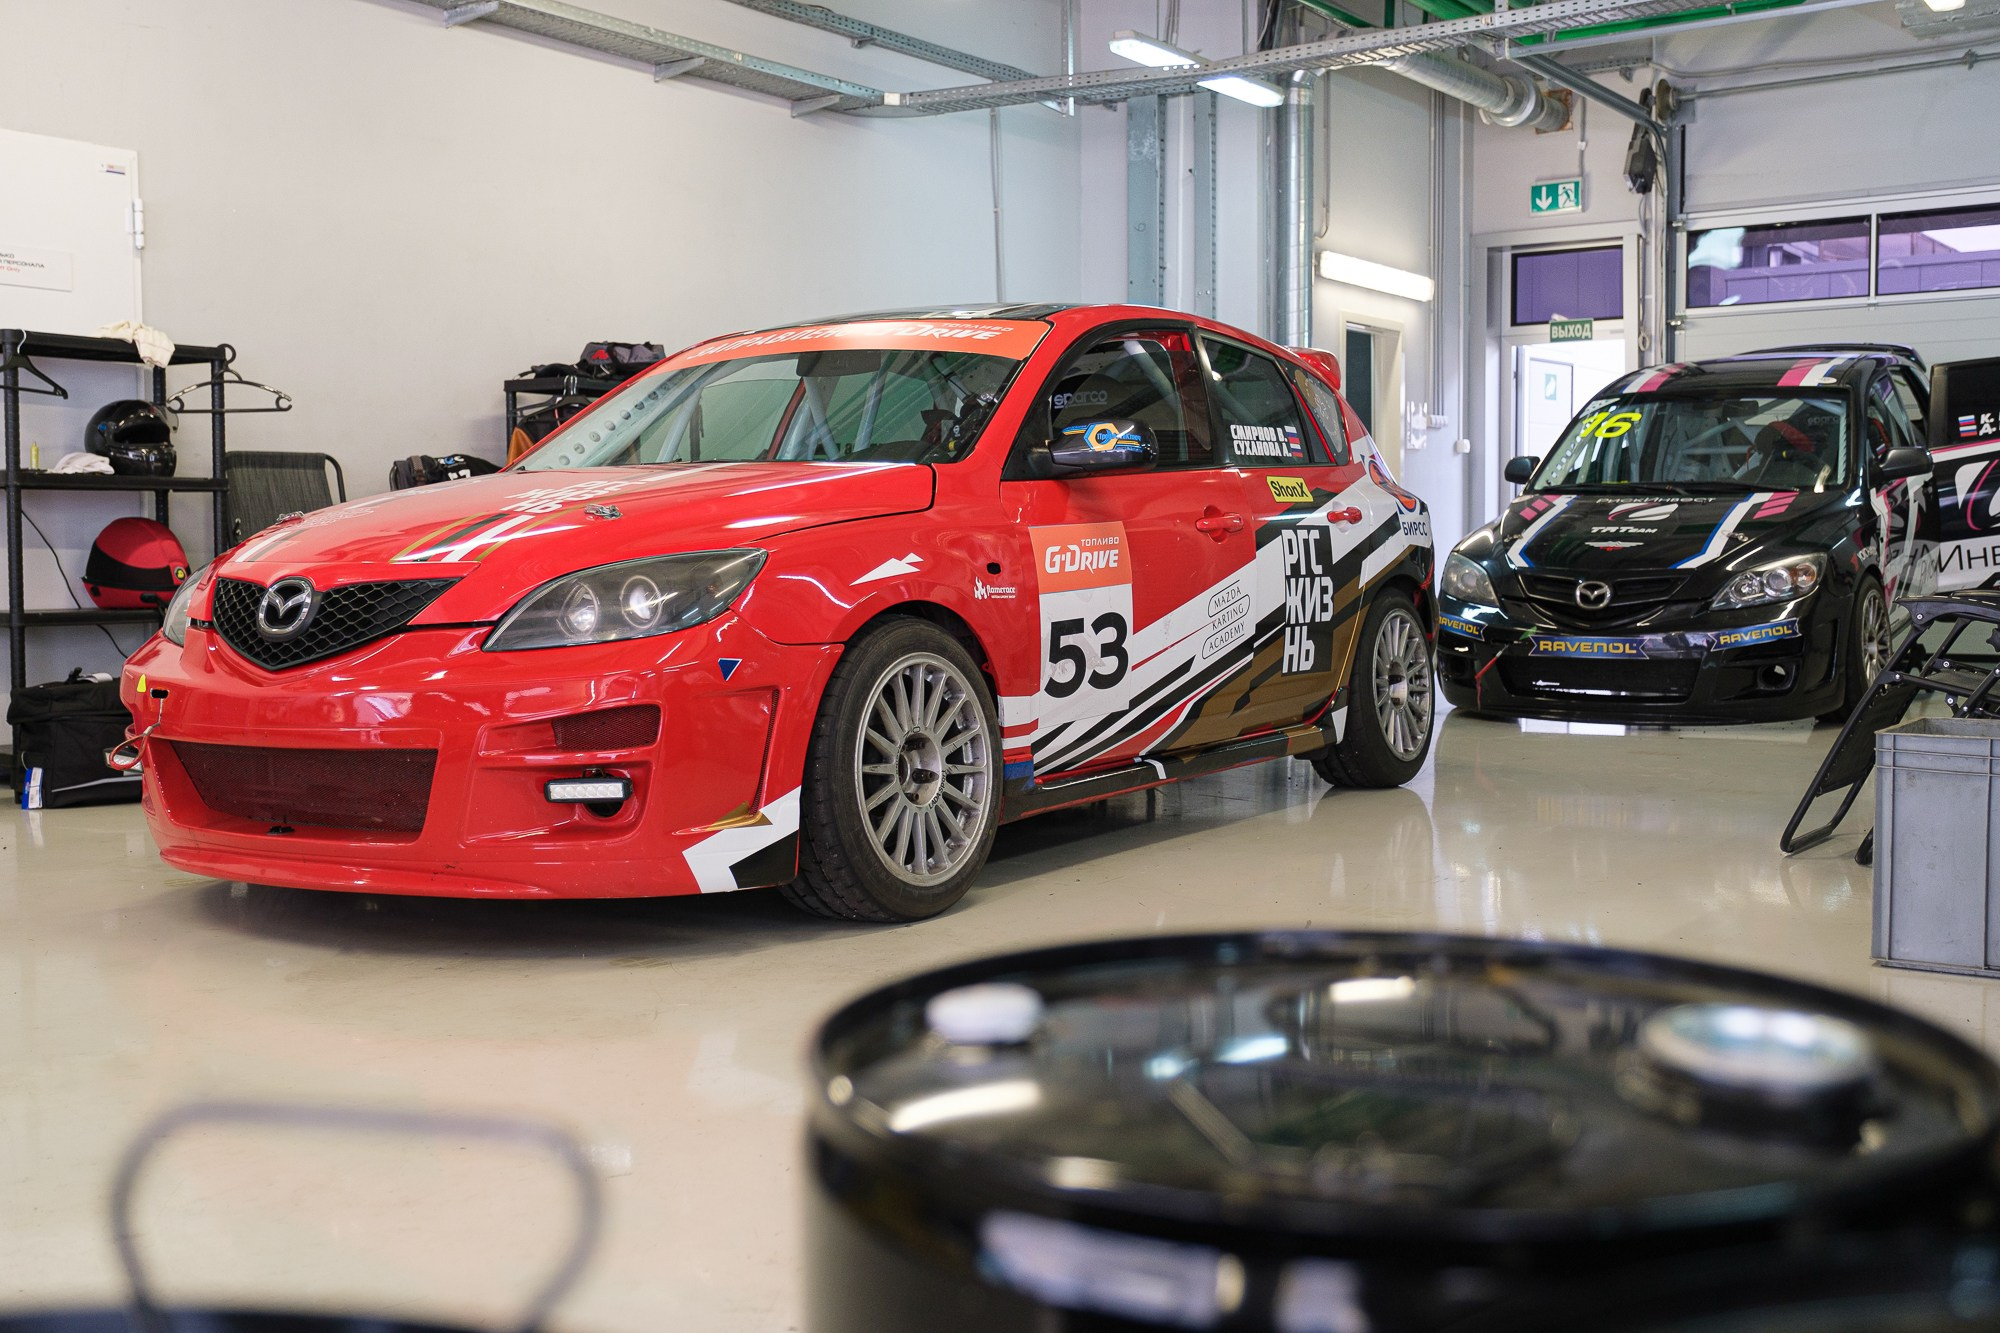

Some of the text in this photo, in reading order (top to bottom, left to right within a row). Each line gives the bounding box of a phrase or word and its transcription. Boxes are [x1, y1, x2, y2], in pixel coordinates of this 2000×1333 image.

[1551, 323, 1592, 340] ВЫХОД
[1230, 424, 1277, 442] СМИРНОВ
[1580, 411, 1642, 438] 16
[1233, 440, 1283, 457] СУХАНОВА
[1270, 480, 1309, 498] ShonX
[1401, 521, 1428, 536] БИРСС
[1081, 536, 1120, 547] ТОПЛИВО
[1281, 529, 1323, 576] РГС
[1214, 586, 1242, 611] MAZDA
[1285, 576, 1334, 625] ЖИЗ
[1212, 603, 1244, 631] KARTING
[1208, 621, 1245, 652] ACADEMY
[1719, 625, 1793, 645] RAVENOL
[1044, 612, 1129, 699] 53
[1282, 625, 1315, 674] НЬ
[1539, 640, 1637, 654] RAVENOL
